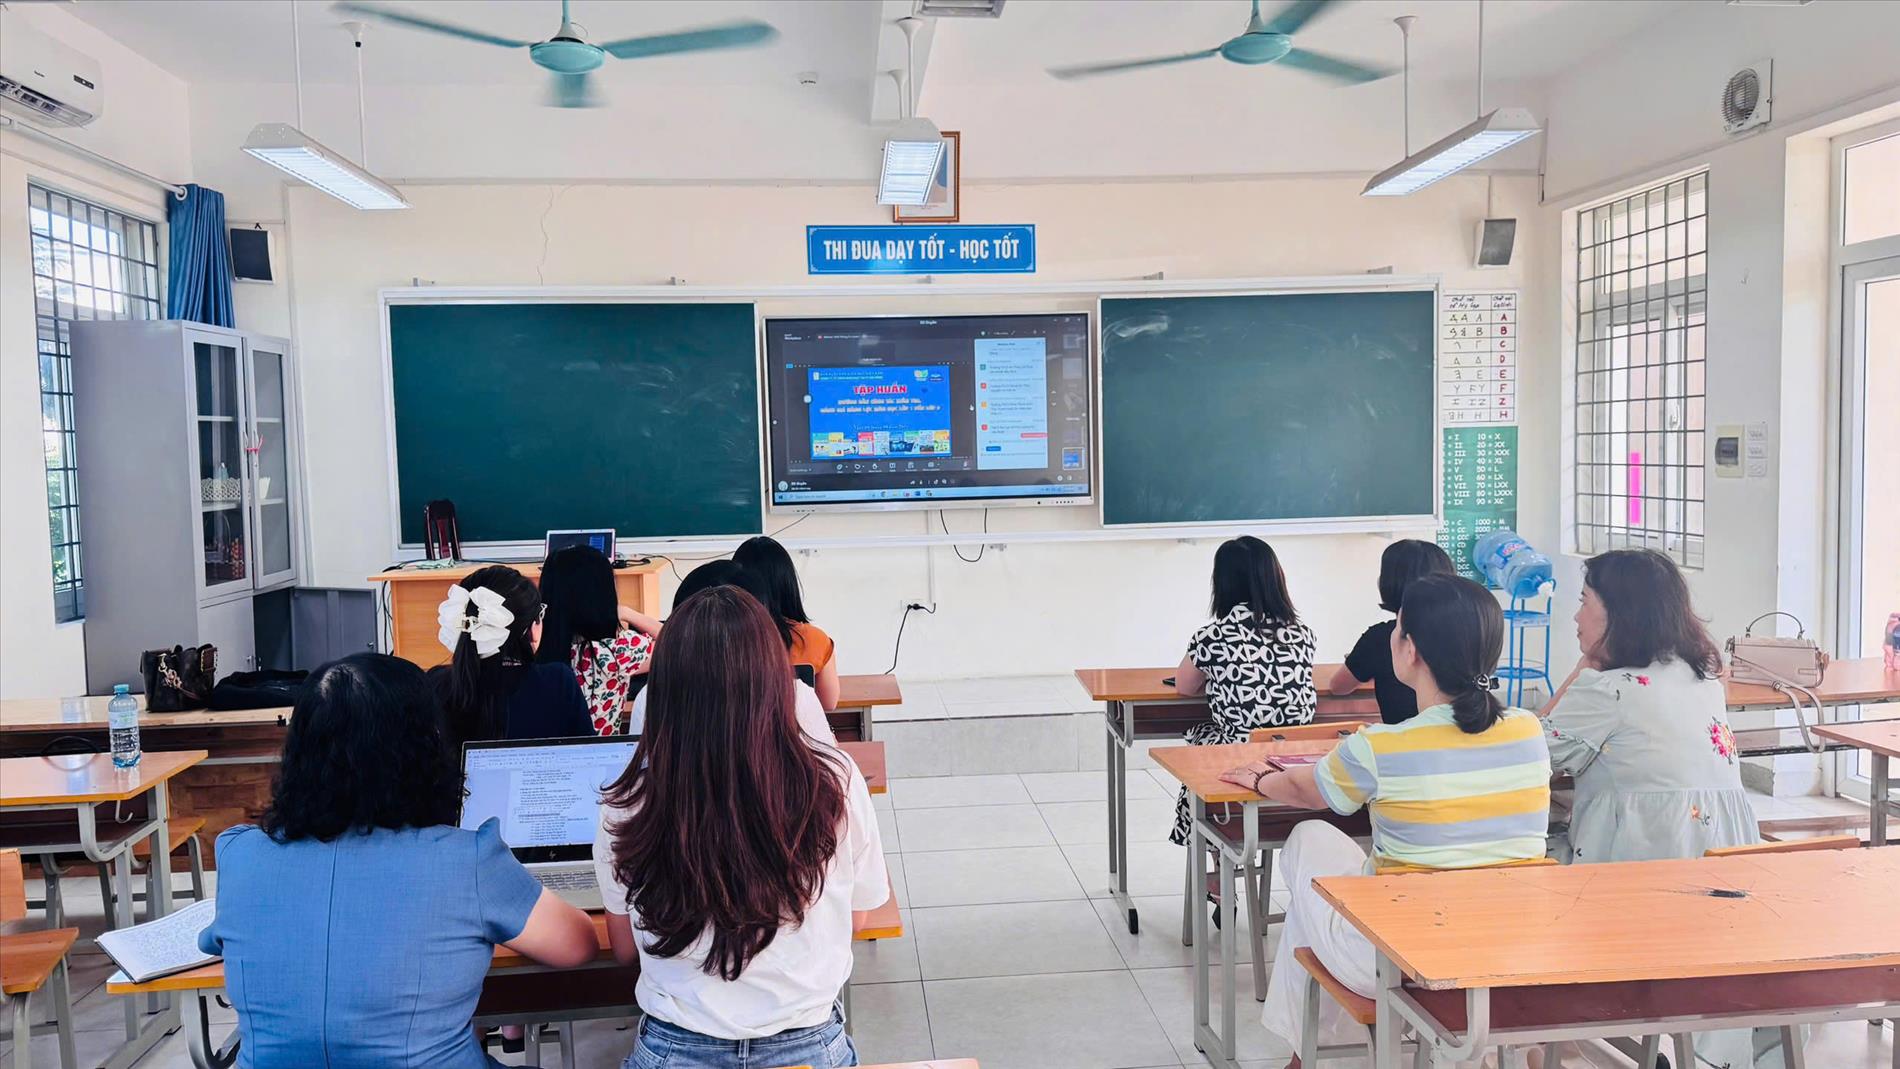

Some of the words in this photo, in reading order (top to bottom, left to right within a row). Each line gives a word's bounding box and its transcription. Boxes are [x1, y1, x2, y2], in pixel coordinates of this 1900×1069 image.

[824, 240, 847, 261] THI
[851, 240, 882, 260] ĐUA
[886, 240, 915, 264] DẠY
[919, 232, 945, 259] TỐT
[960, 240, 989, 263] HỌC
[993, 232, 1019, 259] TỐT
[1500, 313, 1507, 321] A
[1500, 326, 1508, 335] B
[1499, 340, 1506, 348] C
[1500, 355, 1506, 364] D
[1499, 369, 1506, 379] E
[854, 385, 874, 396] TẬP
[877, 381, 907, 394] HUẤN
[1500, 384, 1507, 393] F
[1499, 398, 1506, 406] Z
[1500, 411, 1508, 419] H
